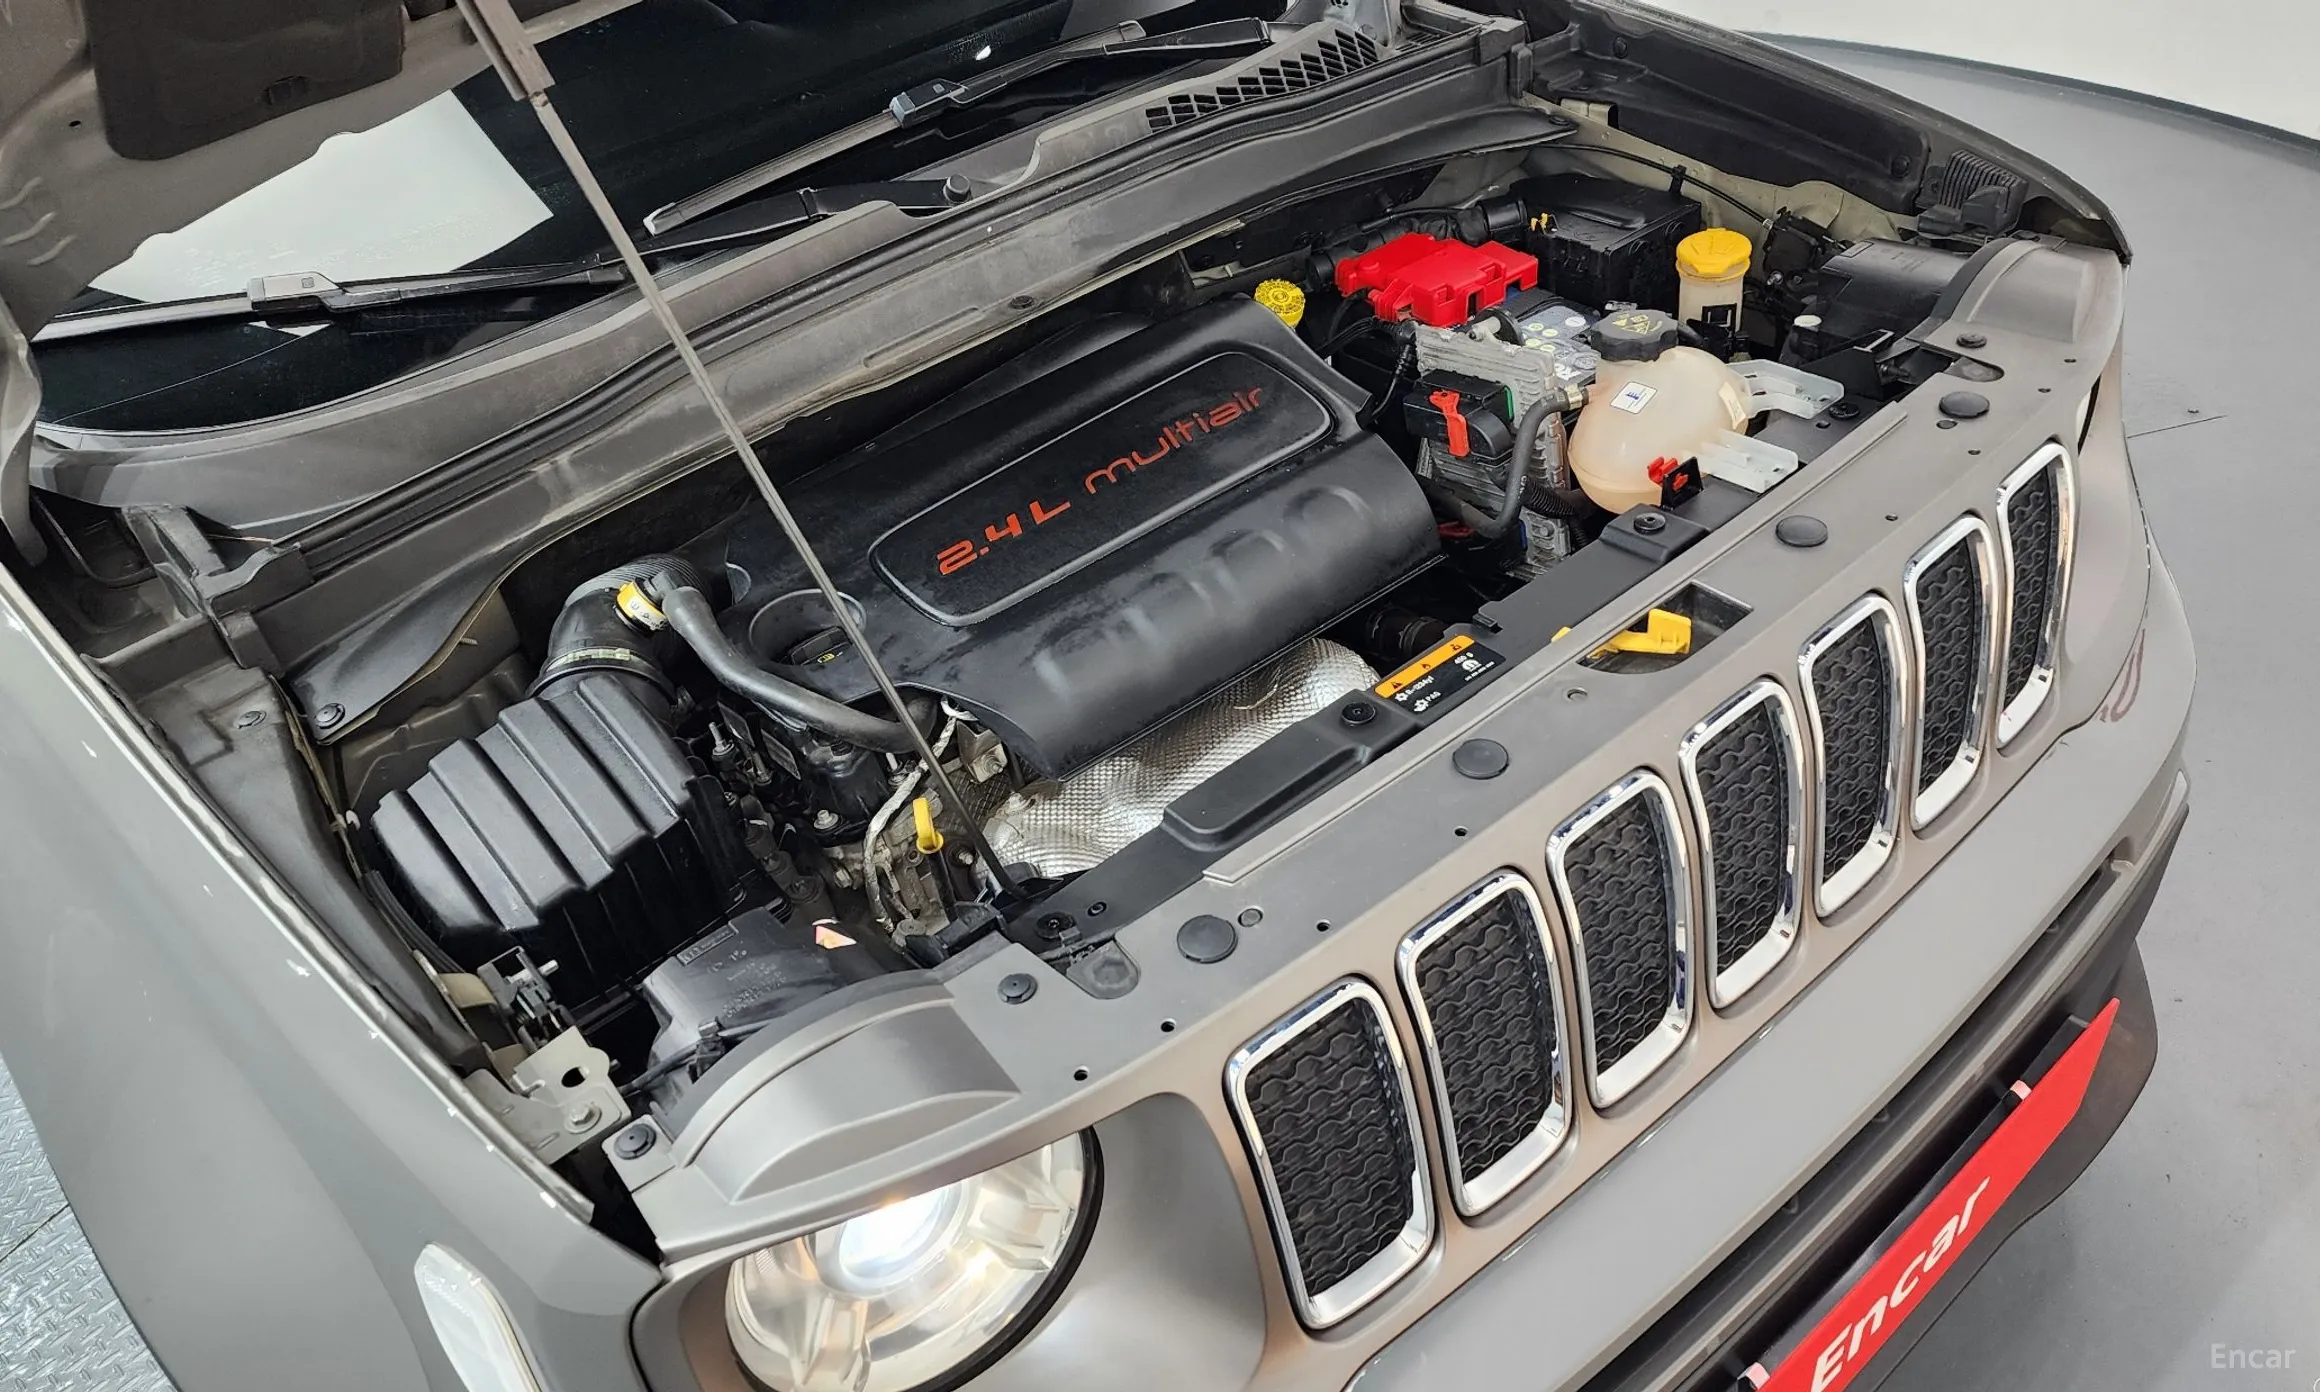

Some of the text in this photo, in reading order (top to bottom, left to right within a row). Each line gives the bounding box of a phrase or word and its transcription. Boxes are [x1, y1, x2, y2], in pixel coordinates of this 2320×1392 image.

[937, 513, 1022, 575] 2.4
[1084, 387, 1262, 495] multiair
[1811, 1176, 1990, 1392] Encar
